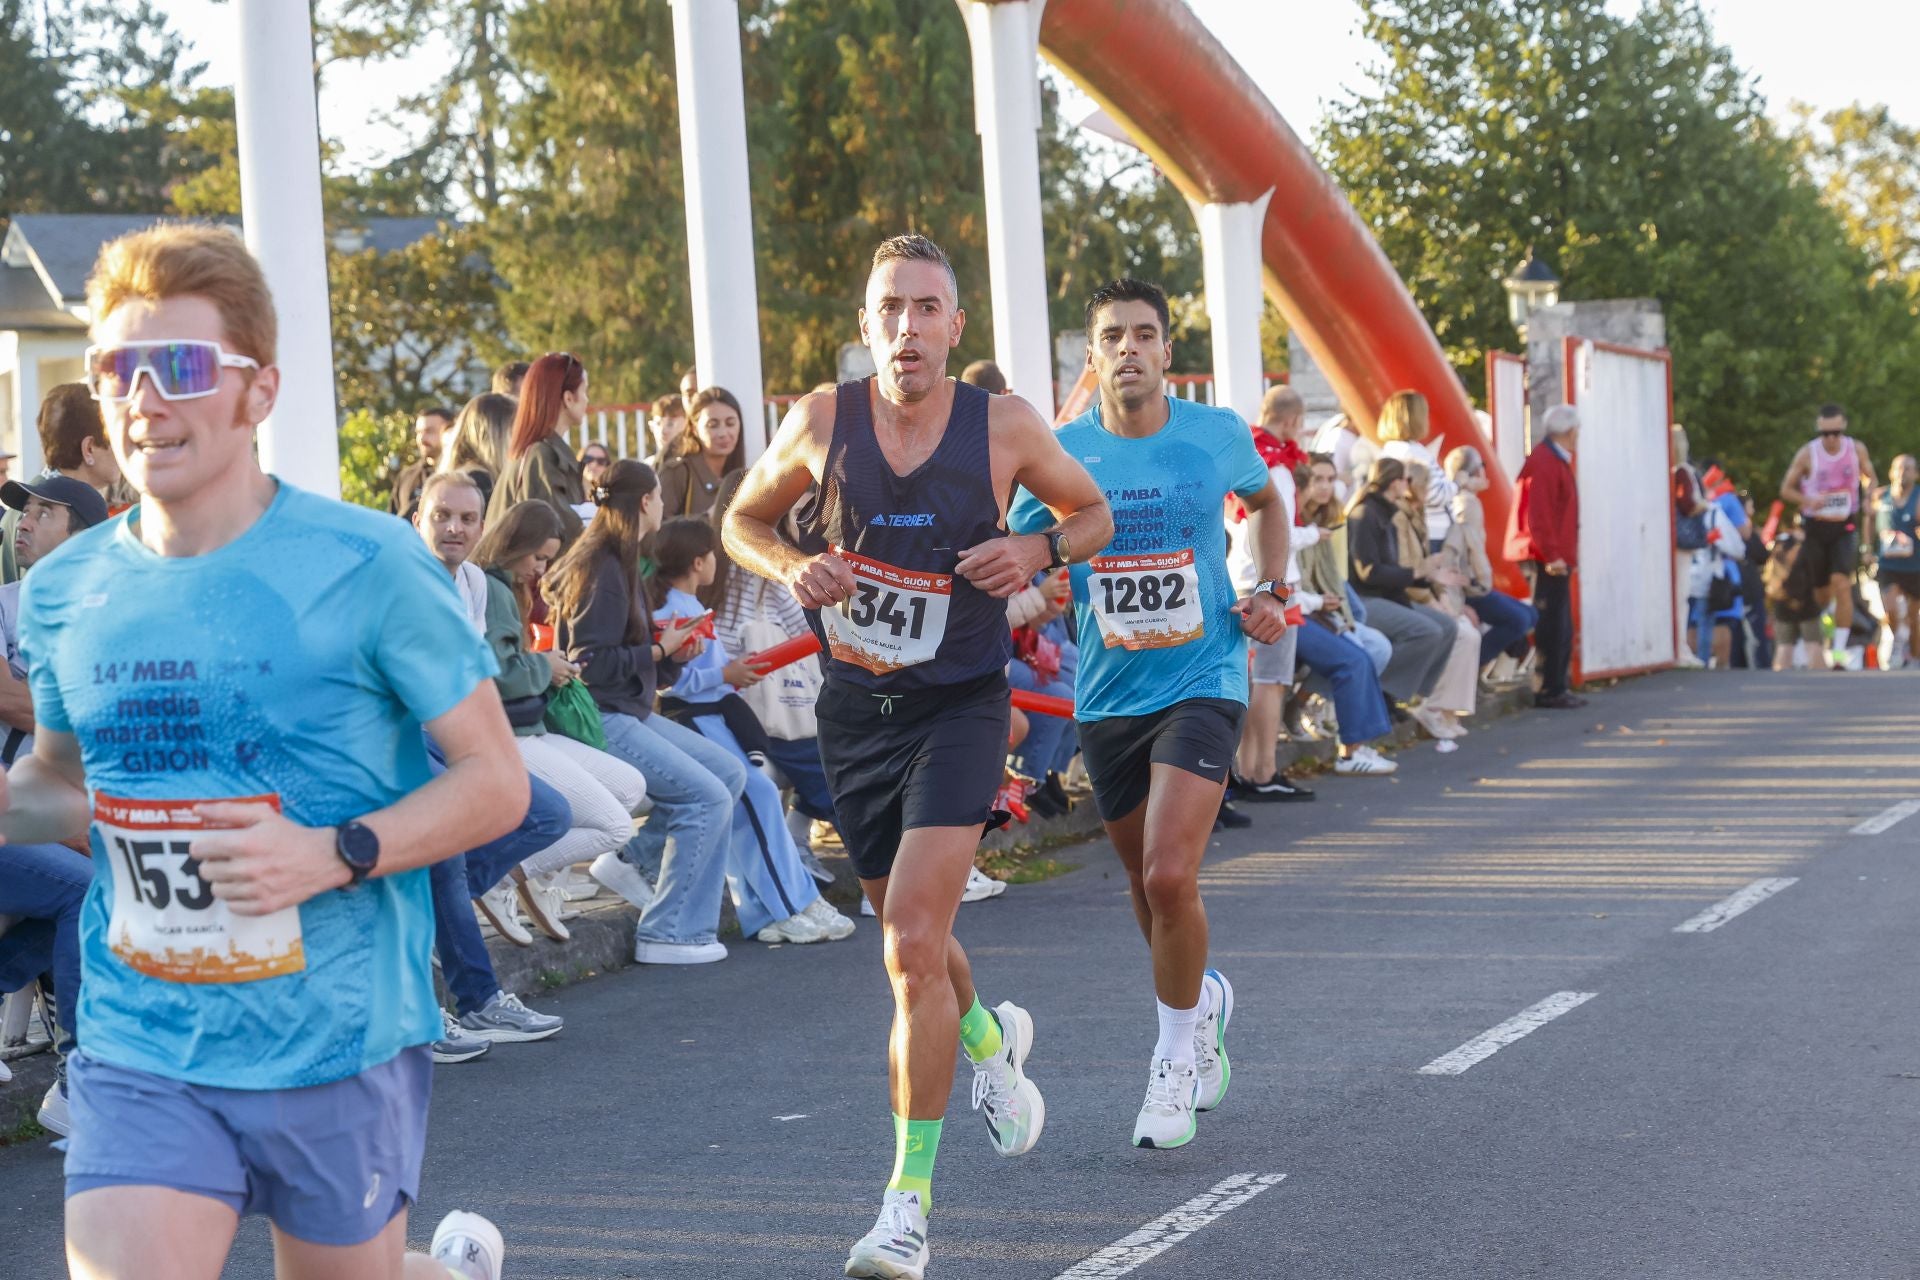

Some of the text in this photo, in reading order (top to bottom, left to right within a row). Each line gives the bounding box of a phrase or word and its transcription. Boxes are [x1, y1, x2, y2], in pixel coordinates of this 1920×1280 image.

[1105, 488, 1162, 501] 4ª MBA
[889, 513, 936, 527] TERREX
[1114, 506, 1163, 519] media
[1114, 520, 1164, 534] aratón
[1112, 535, 1163, 551] GIJÓN
[1157, 557, 1180, 566] GIJÓN
[859, 563, 884, 578] MBA
[903, 577, 931, 588] GIJÓN
[1100, 573, 1187, 614] 1282
[92, 660, 198, 684] 14ª MBA
[116, 690, 201, 718] media
[94, 719, 205, 744] maratón
[122, 746, 209, 773] GIJÓN
[129, 808, 170, 824] MBA
[114, 836, 216, 911] 153
